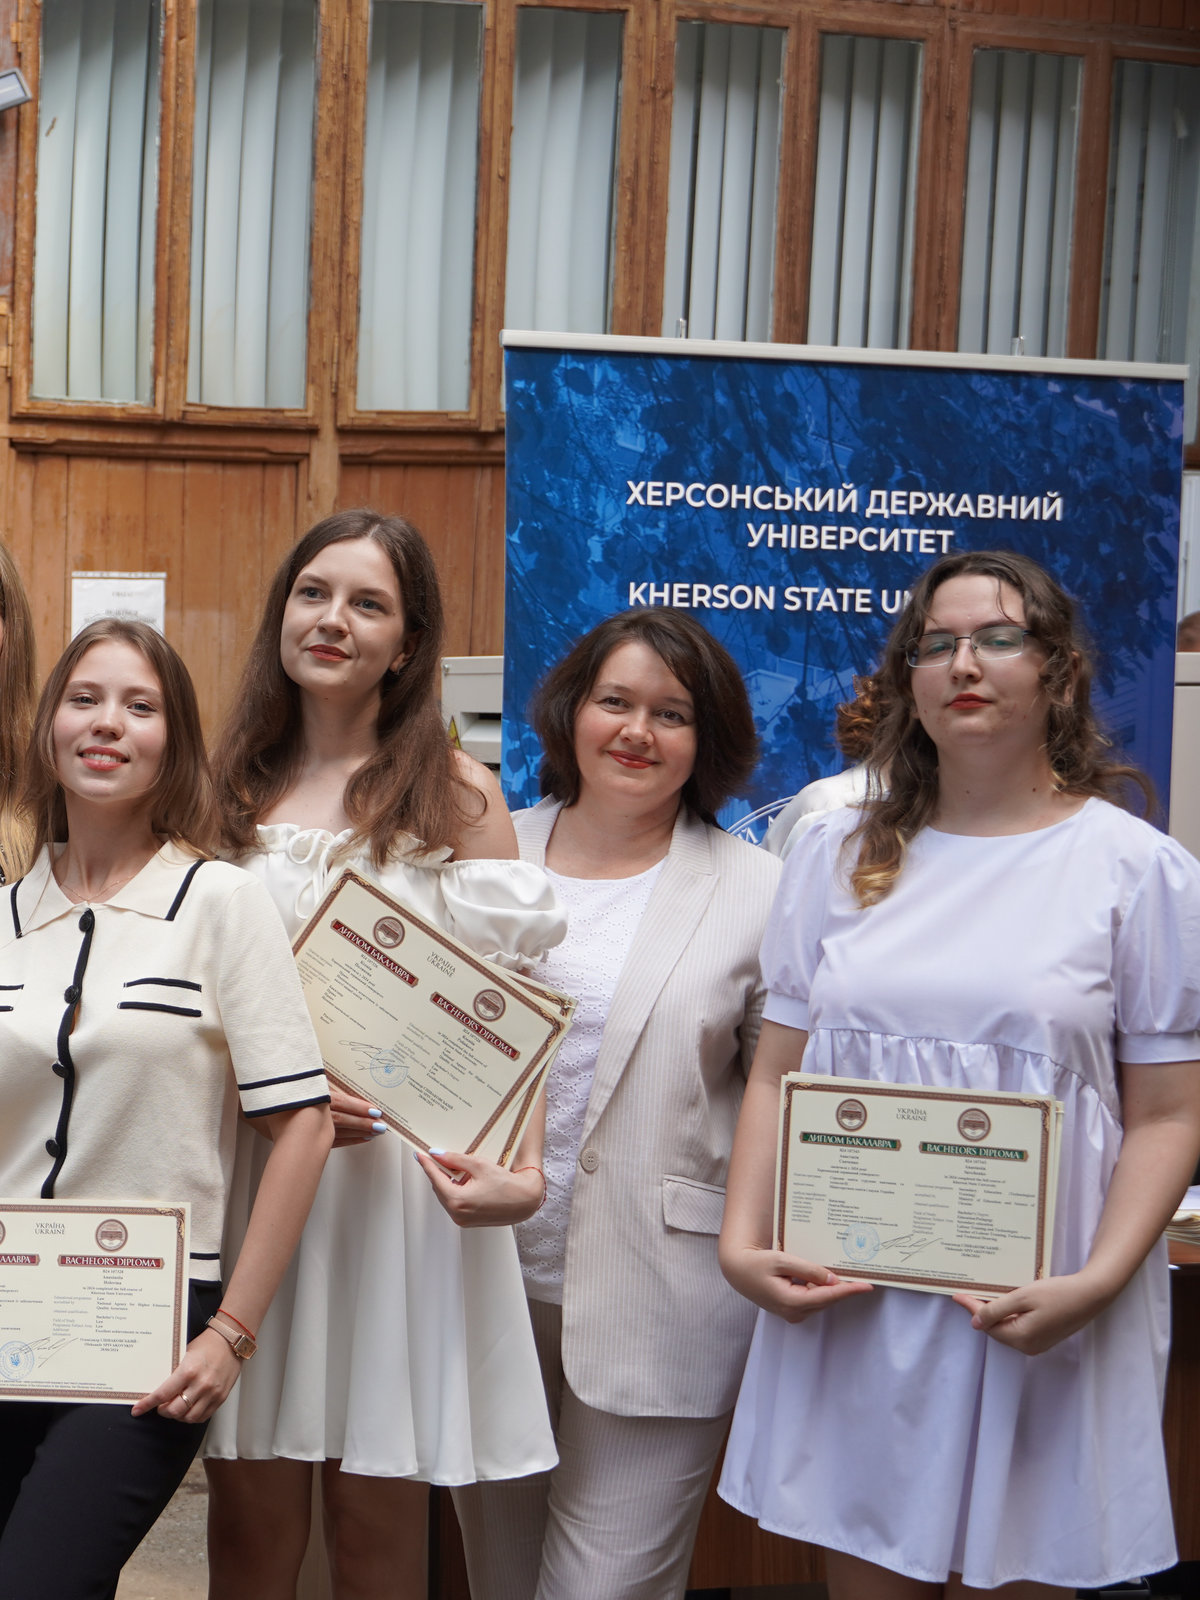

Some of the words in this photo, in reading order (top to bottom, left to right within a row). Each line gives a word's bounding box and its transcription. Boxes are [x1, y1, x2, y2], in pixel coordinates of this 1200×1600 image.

[626, 480, 858, 513] ХЕРСОНСЬКИЙ
[865, 490, 1062, 521] ДЕРЖАВНИЙ
[746, 523, 954, 554] УНІВЕРСИТЕТ
[629, 582, 775, 610] KHERSON
[783, 586, 872, 613] STATE
[337, 924, 371, 953] ДИПЛОМ
[369, 949, 410, 982] БАКАЛАВРА
[431, 951, 457, 973] УКРАЇНА
[426, 956, 454, 978] UKRAINE
[478, 1027, 513, 1056] DIPLOMA
[896, 1107, 927, 1116] УКРАЇНА
[896, 1114, 927, 1122] UKRAINE
[808, 1134, 844, 1144] ДИПЛОМ
[846, 1136, 892, 1148] БАКАЛАВРА
[979, 1149, 1020, 1159] DIPLOMA
[117, 1258, 156, 1267] DIPLOMA
